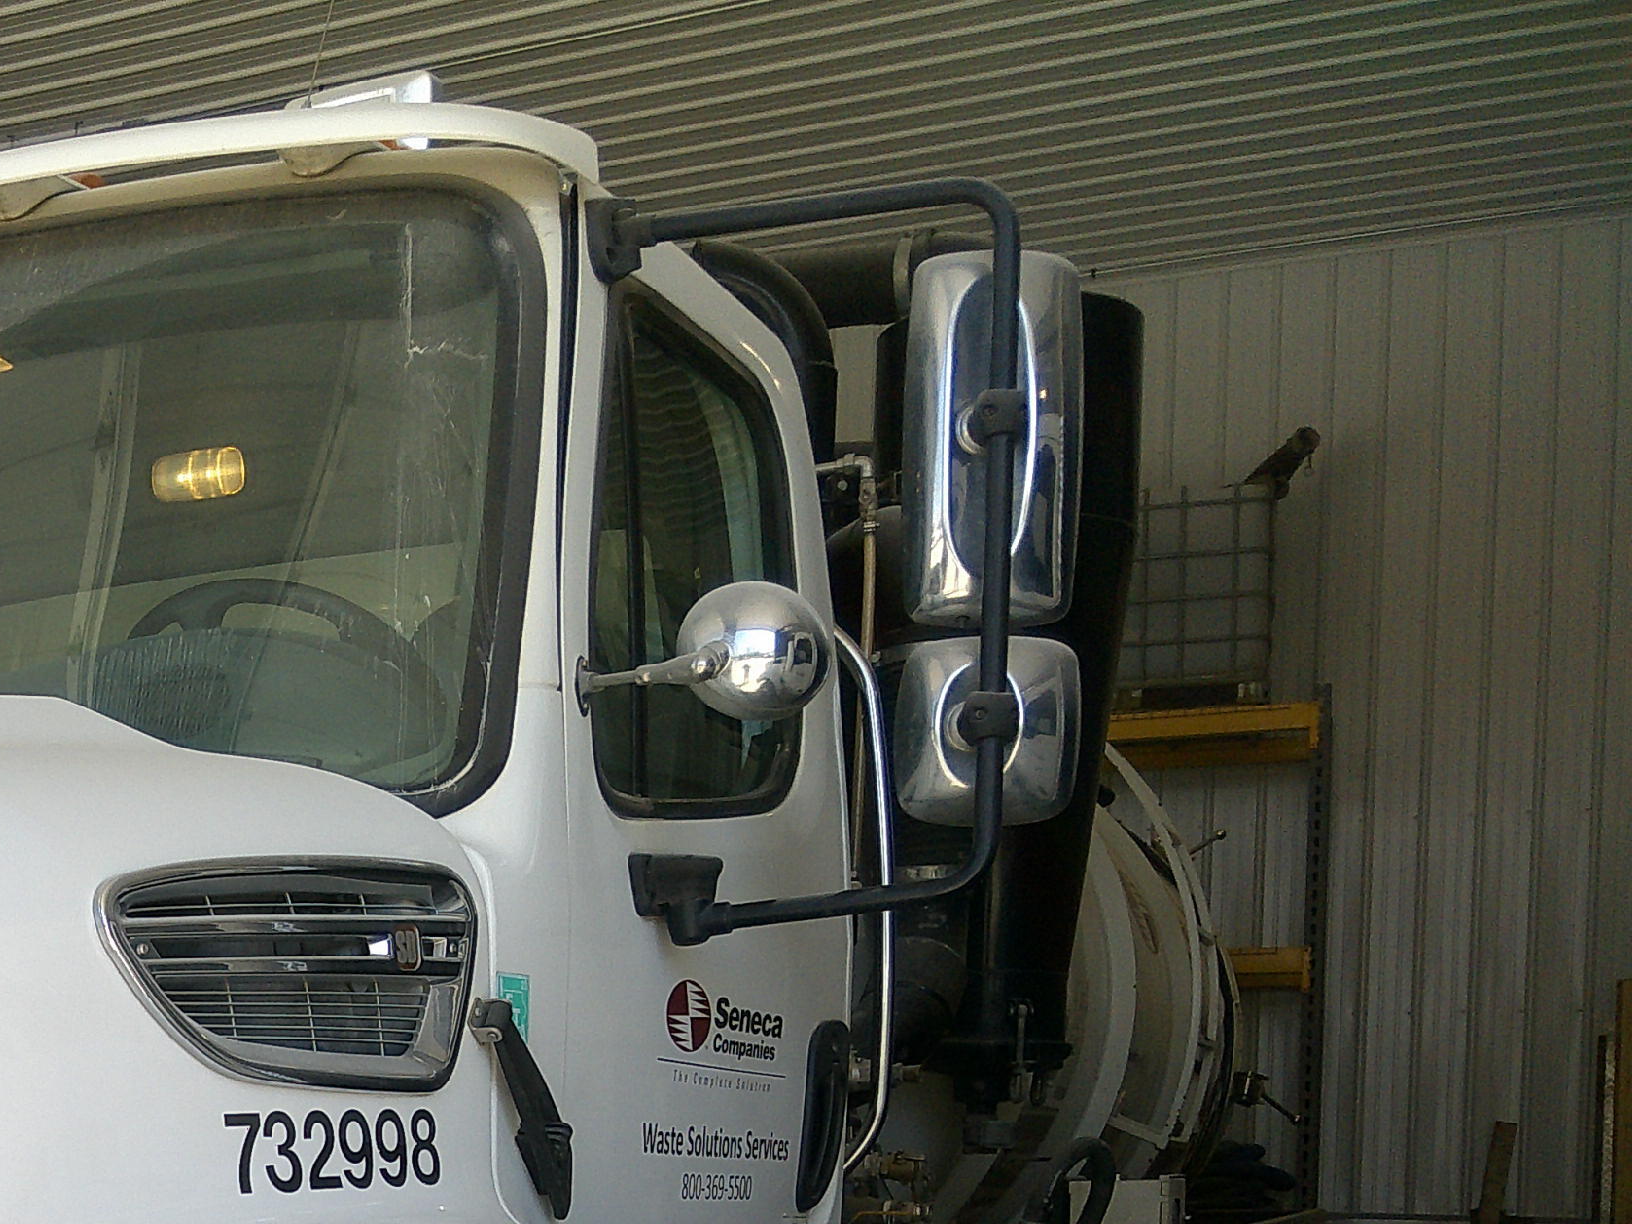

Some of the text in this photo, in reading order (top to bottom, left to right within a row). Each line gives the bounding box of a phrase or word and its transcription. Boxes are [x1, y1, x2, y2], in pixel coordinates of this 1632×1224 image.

[714, 997, 783, 1039] Seneca
[713, 1033, 776, 1061] Companies
[673, 1069, 689, 1083] The
[223, 1108, 441, 1194] 732998
[642, 1122, 790, 1161] Waste Solutions Services
[681, 1173, 753, 1201] 800-369-5500
